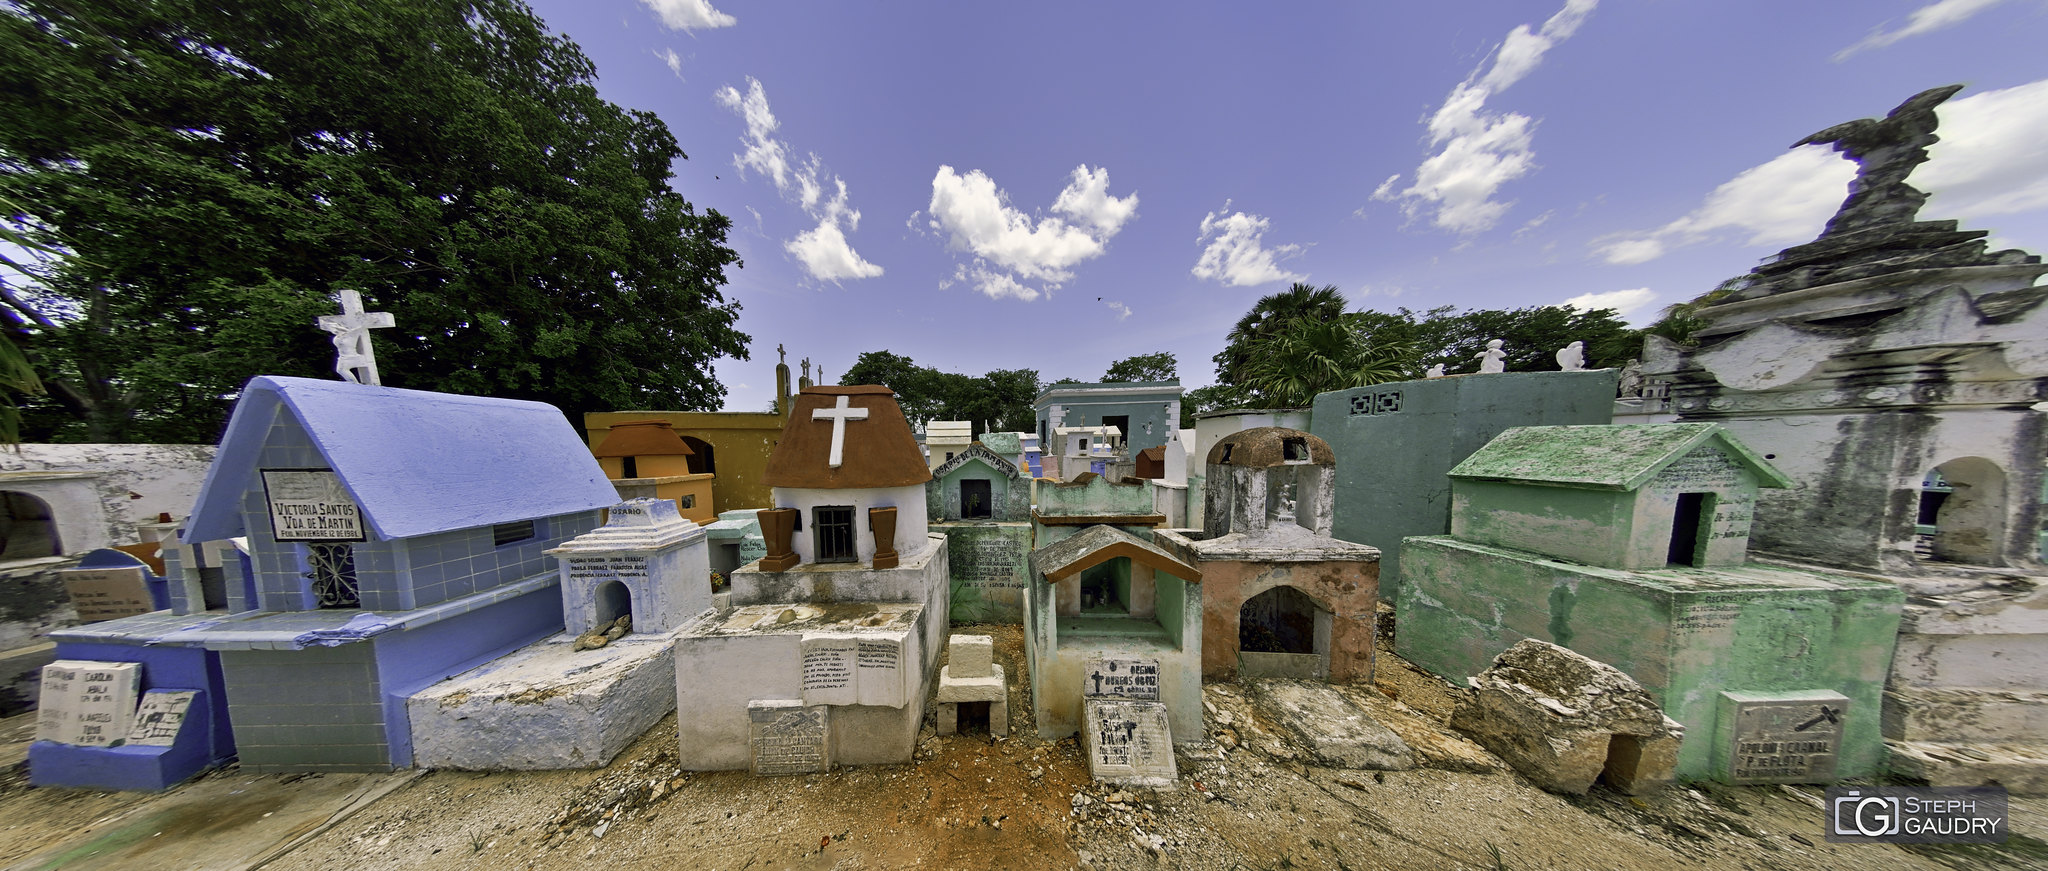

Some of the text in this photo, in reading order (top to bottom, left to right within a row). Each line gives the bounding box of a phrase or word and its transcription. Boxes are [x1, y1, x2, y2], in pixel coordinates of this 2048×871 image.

[935, 456, 960, 476] OSARIO
[960, 450, 971, 461] DE
[970, 447, 981, 457] LA
[275, 503, 354, 516] VICTORIA SANTOS
[307, 518, 316, 529] DE
[317, 516, 354, 529] MARTIN
[295, 530, 328, 538] NOVIEMBRE
[329, 530, 335, 538] 12
[336, 530, 344, 538] DE
[1105, 675, 1133, 686] BURGOS
